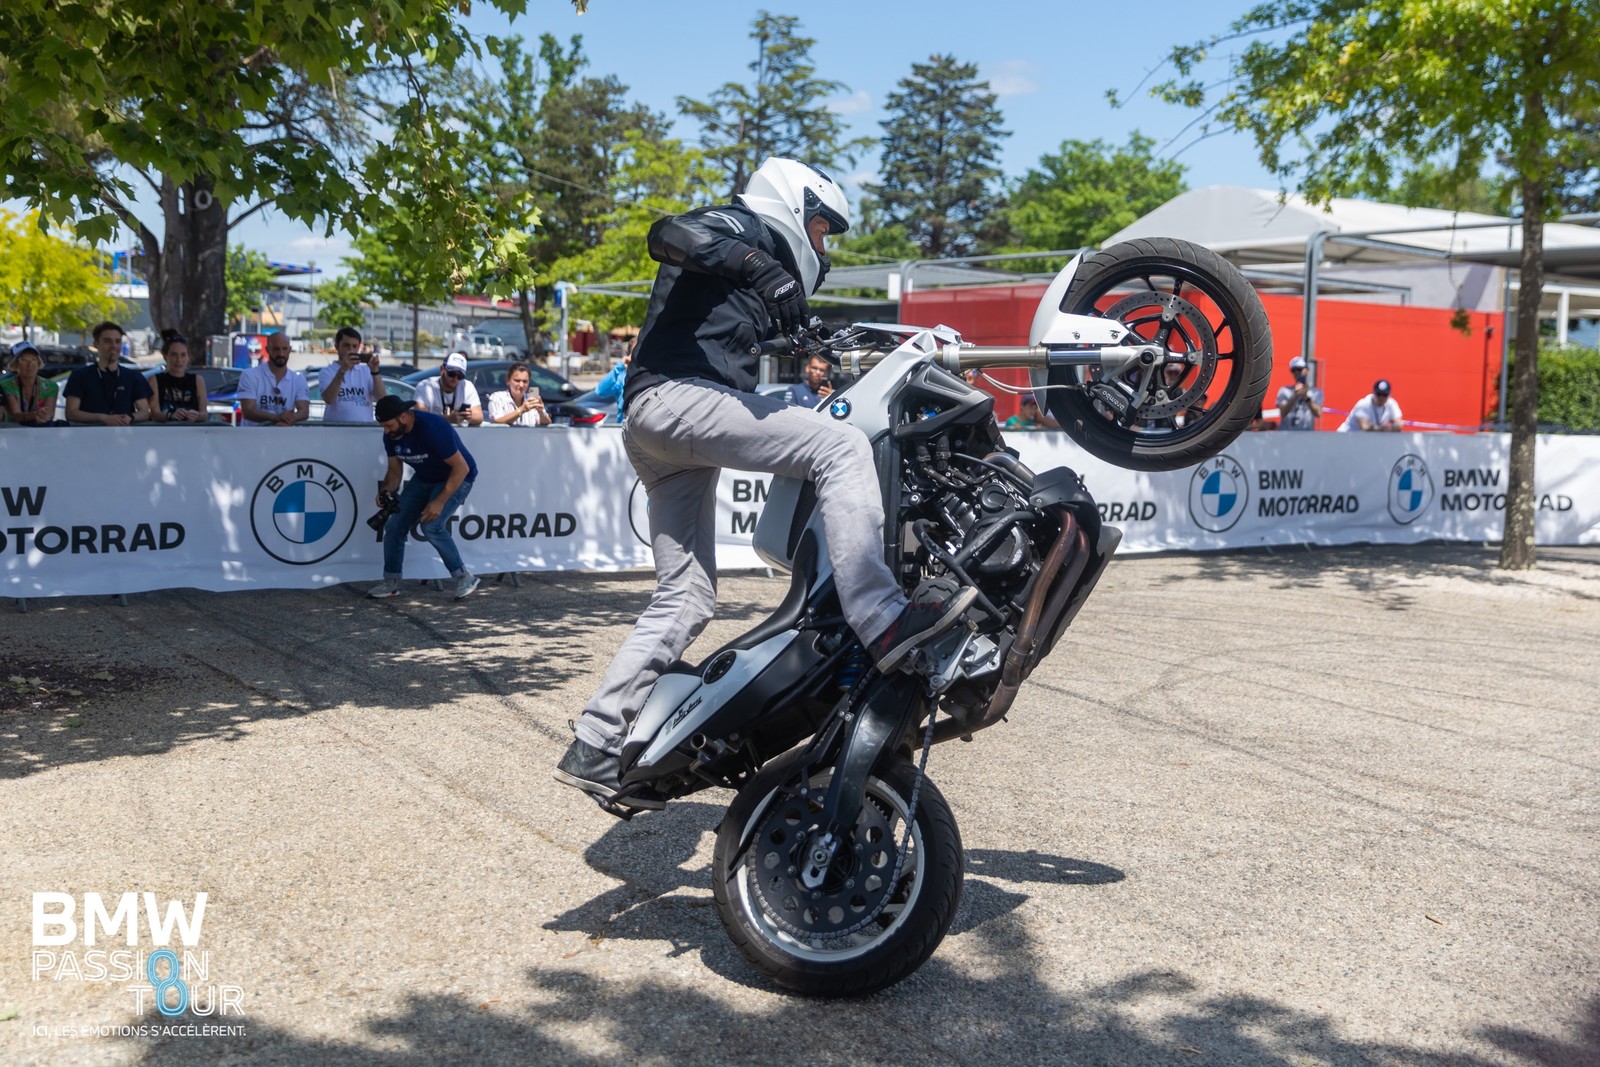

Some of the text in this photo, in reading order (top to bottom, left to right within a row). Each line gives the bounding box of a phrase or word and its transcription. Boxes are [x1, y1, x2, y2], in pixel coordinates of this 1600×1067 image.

[260, 394, 288, 406] BMW
[338, 386, 365, 397] BMW
[1102, 390, 1125, 412] brembo
[264, 464, 344, 493] BMW
[1198, 458, 1241, 480] BMW
[1258, 470, 1303, 490] BMW
[1443, 469, 1501, 488] BMW
[733, 479, 770, 503] BM
[1258, 494, 1359, 517] MOTORRAD
[1441, 493, 1573, 512] MOTOAD
[0, 524, 186, 555] TORRAD
